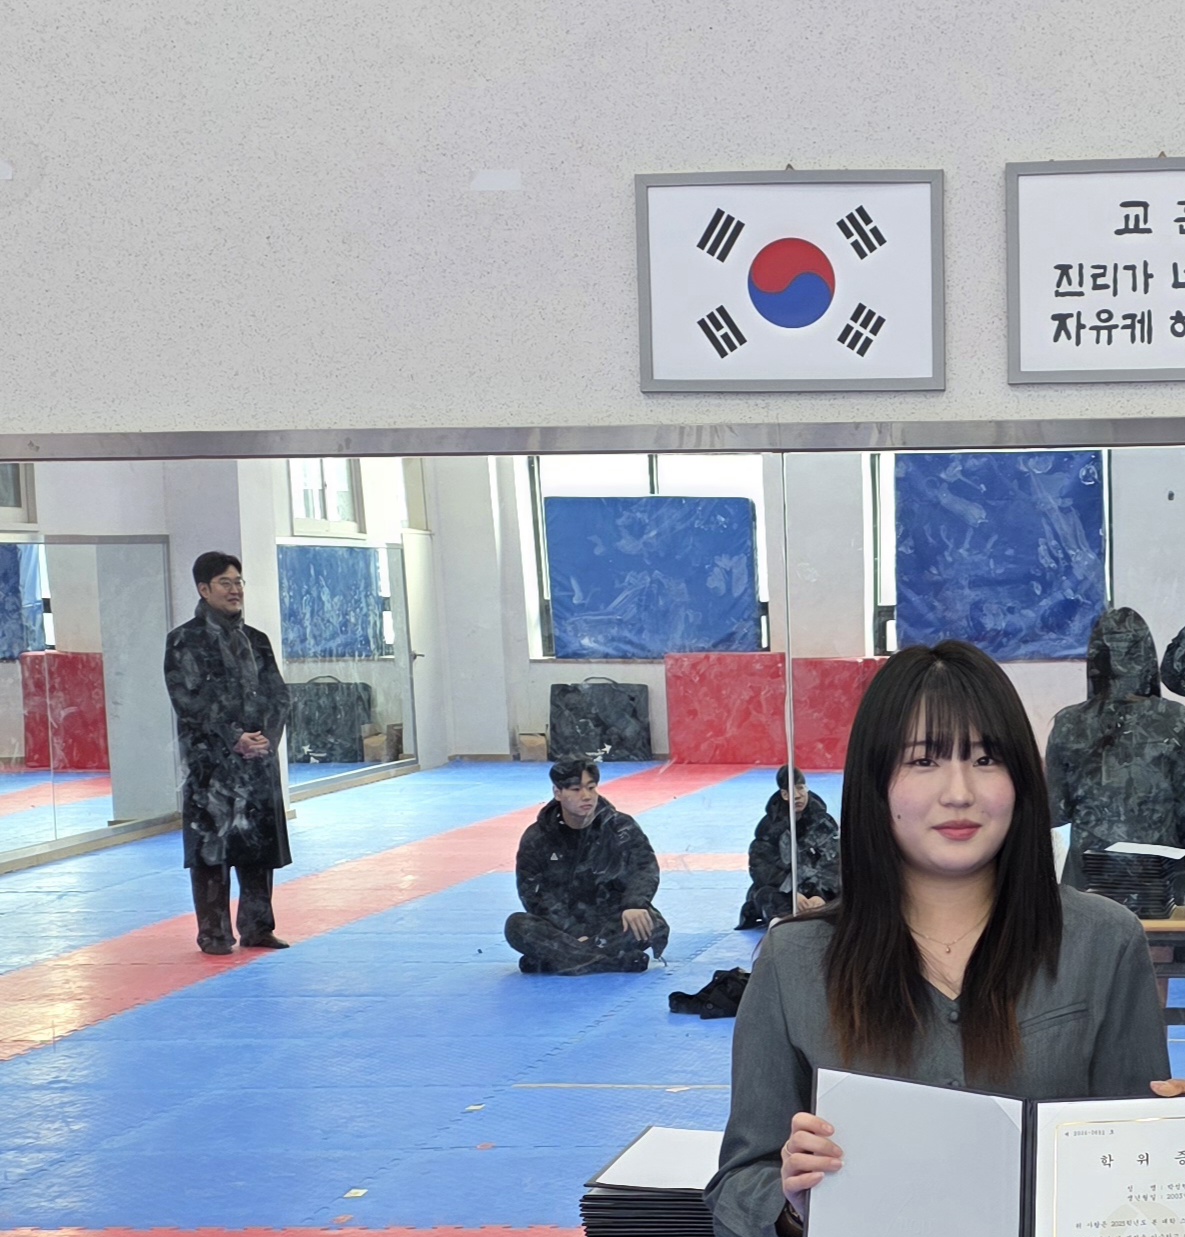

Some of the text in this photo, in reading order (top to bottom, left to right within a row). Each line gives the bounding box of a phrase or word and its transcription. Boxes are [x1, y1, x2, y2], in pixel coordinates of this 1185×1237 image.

[1113, 200, 1153, 236] 교
[1053, 259, 1154, 298] 진리가
[1050, 308, 1153, 347] 자유케
